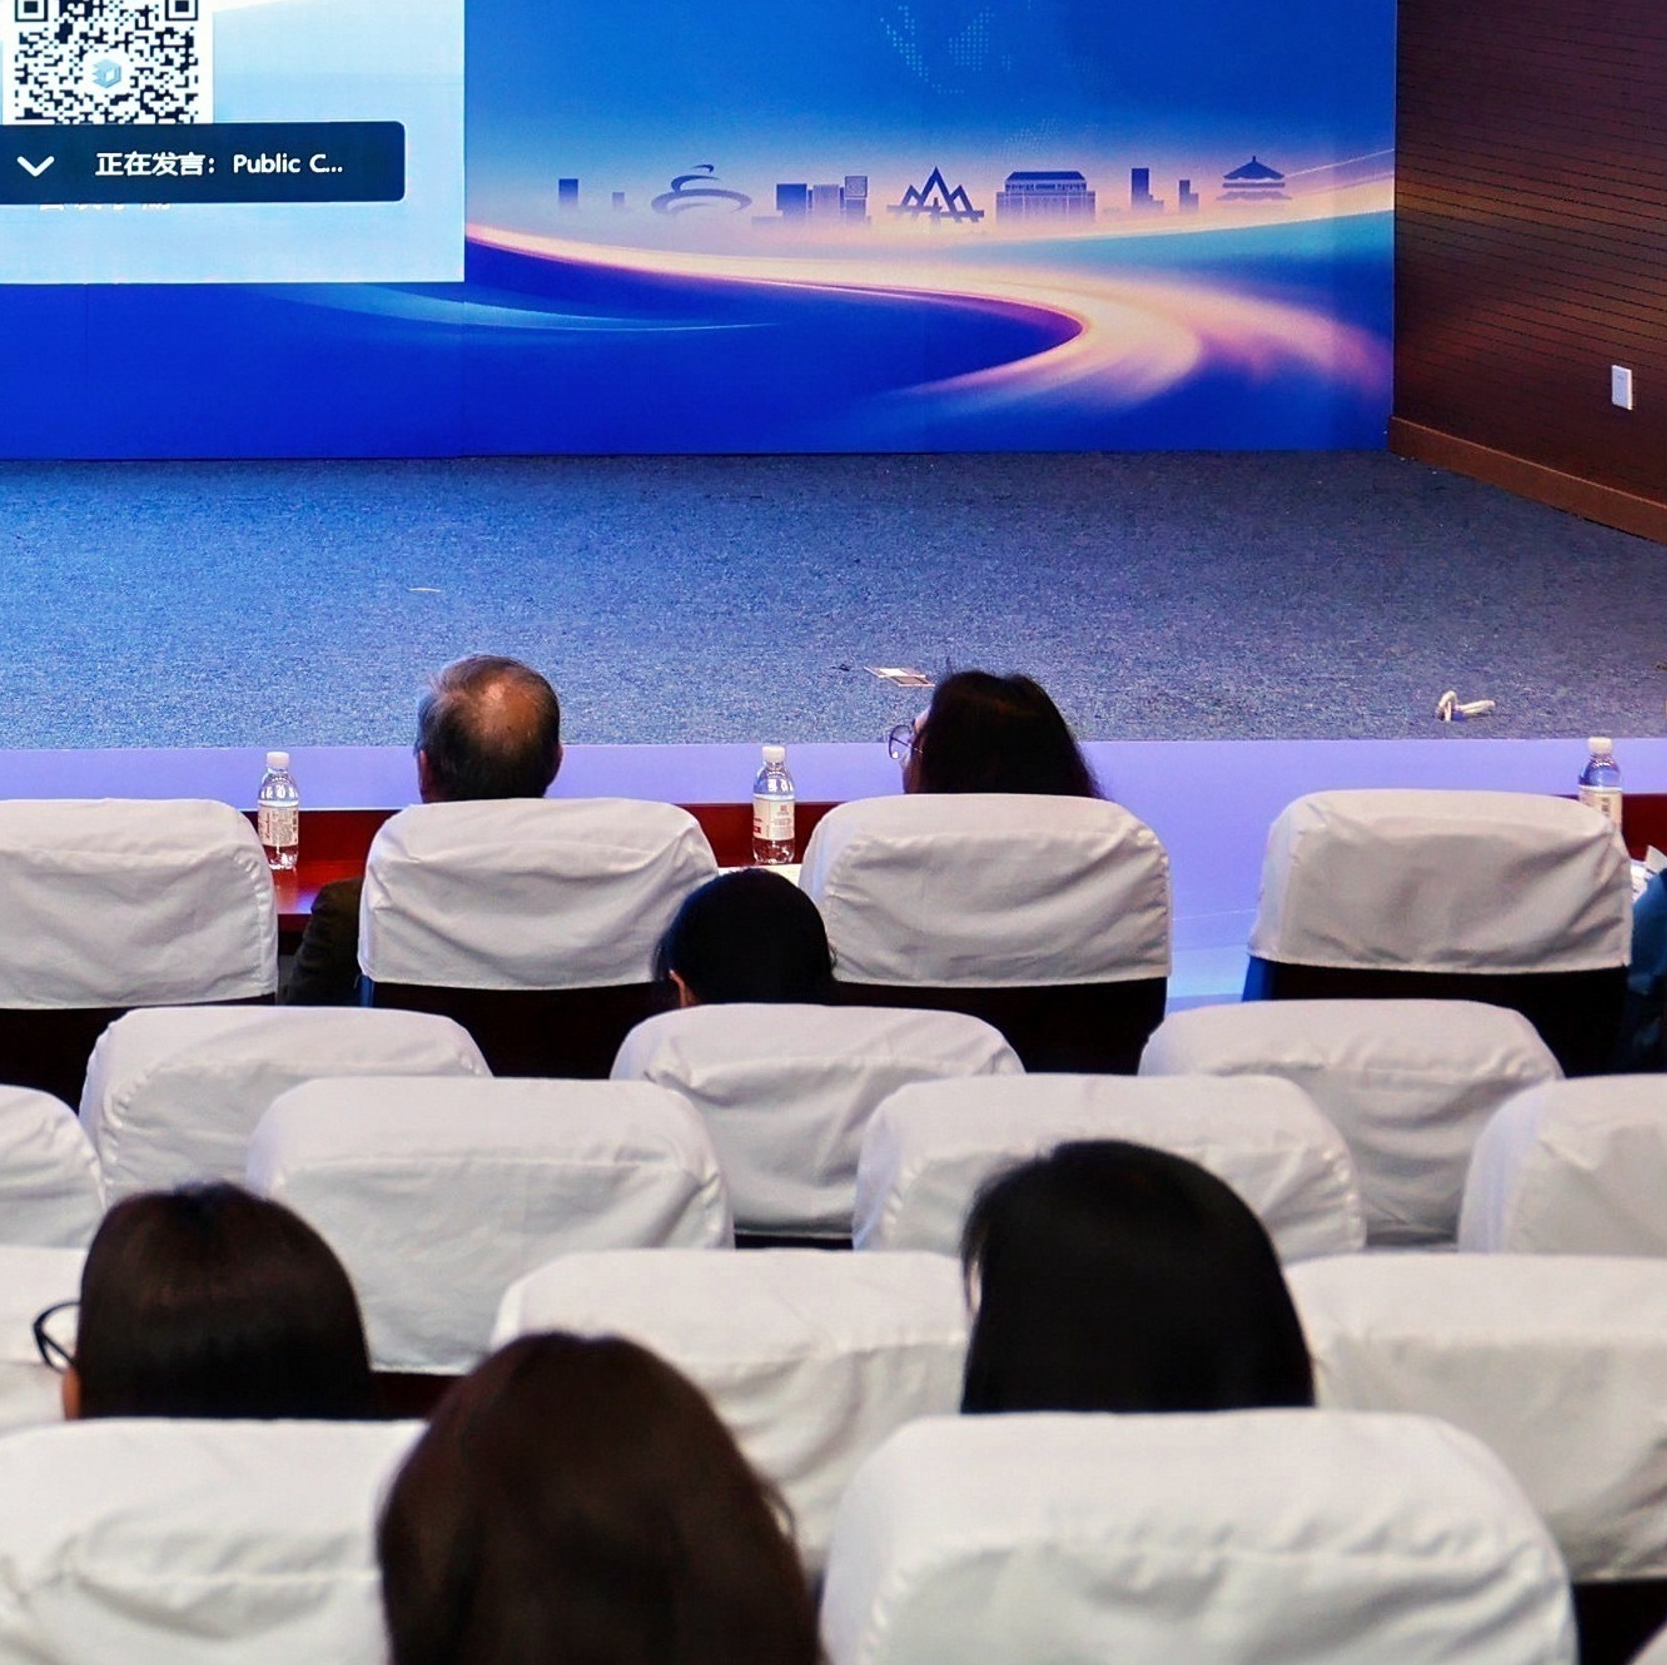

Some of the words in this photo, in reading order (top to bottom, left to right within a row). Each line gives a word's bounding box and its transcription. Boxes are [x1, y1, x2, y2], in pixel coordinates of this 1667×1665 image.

[95, 151, 214, 176] 正在发言：
[234, 153, 300, 173] Public
